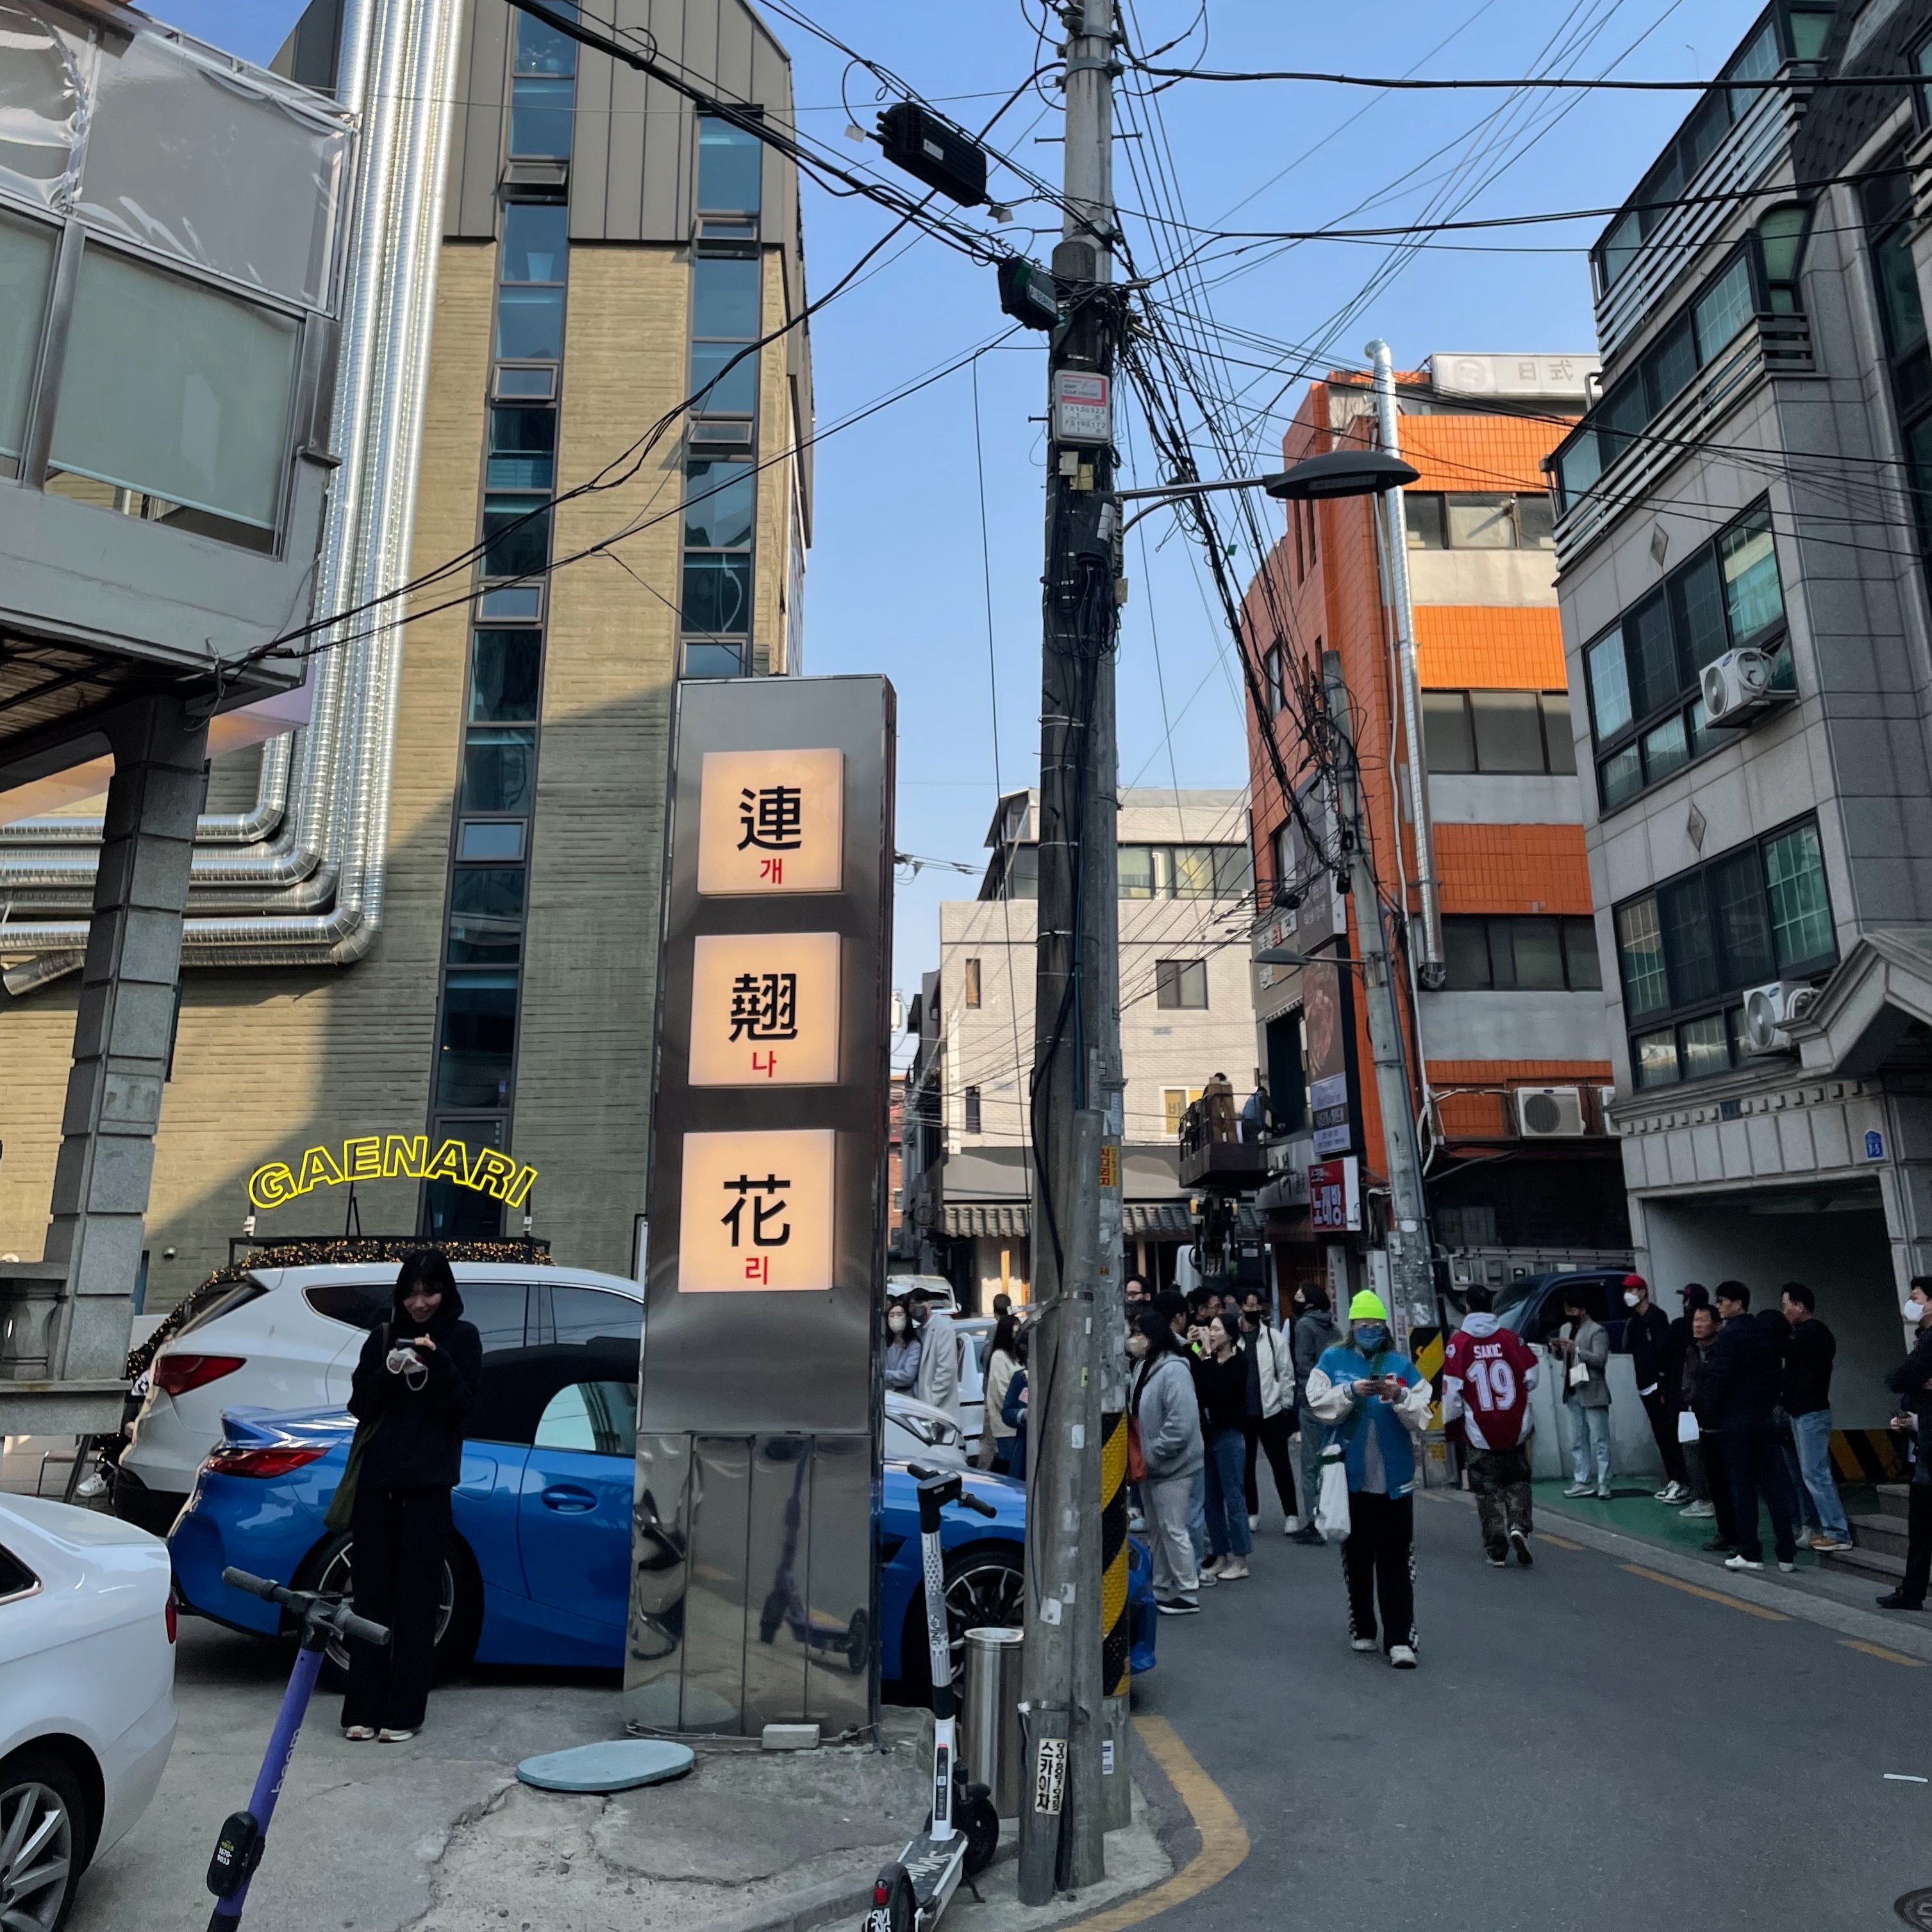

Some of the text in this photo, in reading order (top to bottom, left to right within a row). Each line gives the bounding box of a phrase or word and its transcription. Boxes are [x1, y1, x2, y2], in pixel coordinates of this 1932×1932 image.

[737, 786, 802, 851] 連
[760, 858, 782, 885] 개
[728, 973, 798, 1043] 翹
[753, 1051, 777, 1078] 나
[248, 1135, 538, 1209] GAENARI
[720, 1174, 790, 1247] 花
[745, 1256, 768, 1285] 리
[1465, 1359, 1517, 1412] 19
[1036, 1742, 1053, 1810] 스카이차
